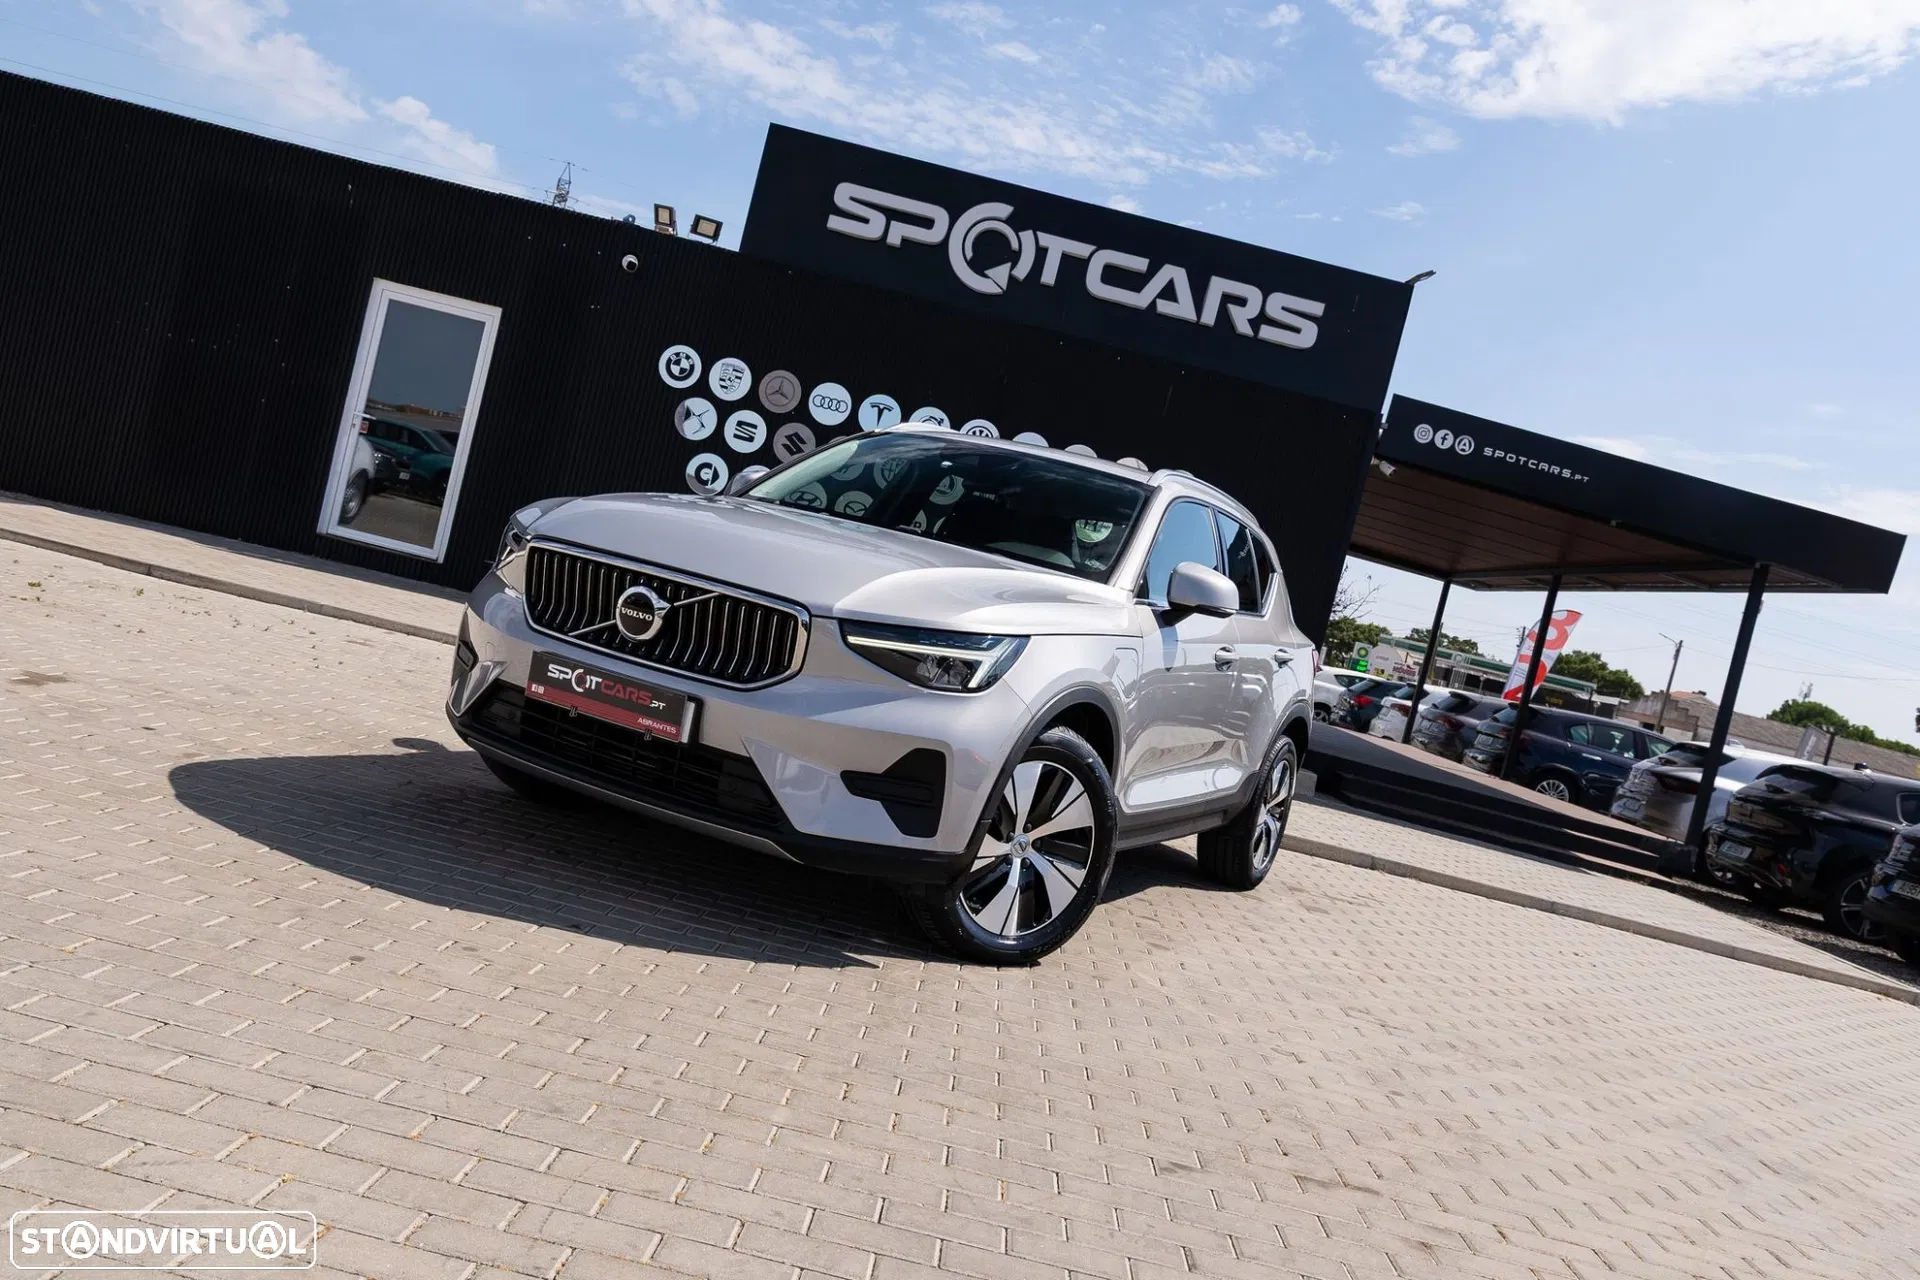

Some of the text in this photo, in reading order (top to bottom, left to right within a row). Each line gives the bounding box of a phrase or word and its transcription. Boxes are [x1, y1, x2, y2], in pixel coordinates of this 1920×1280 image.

[827, 181, 1326, 350] SPOTCARS
[1483, 447, 1590, 483] SPOTCARS.PT
[621, 606, 653, 621] VOLVO
[637, 717, 677, 734] ABRANTES
